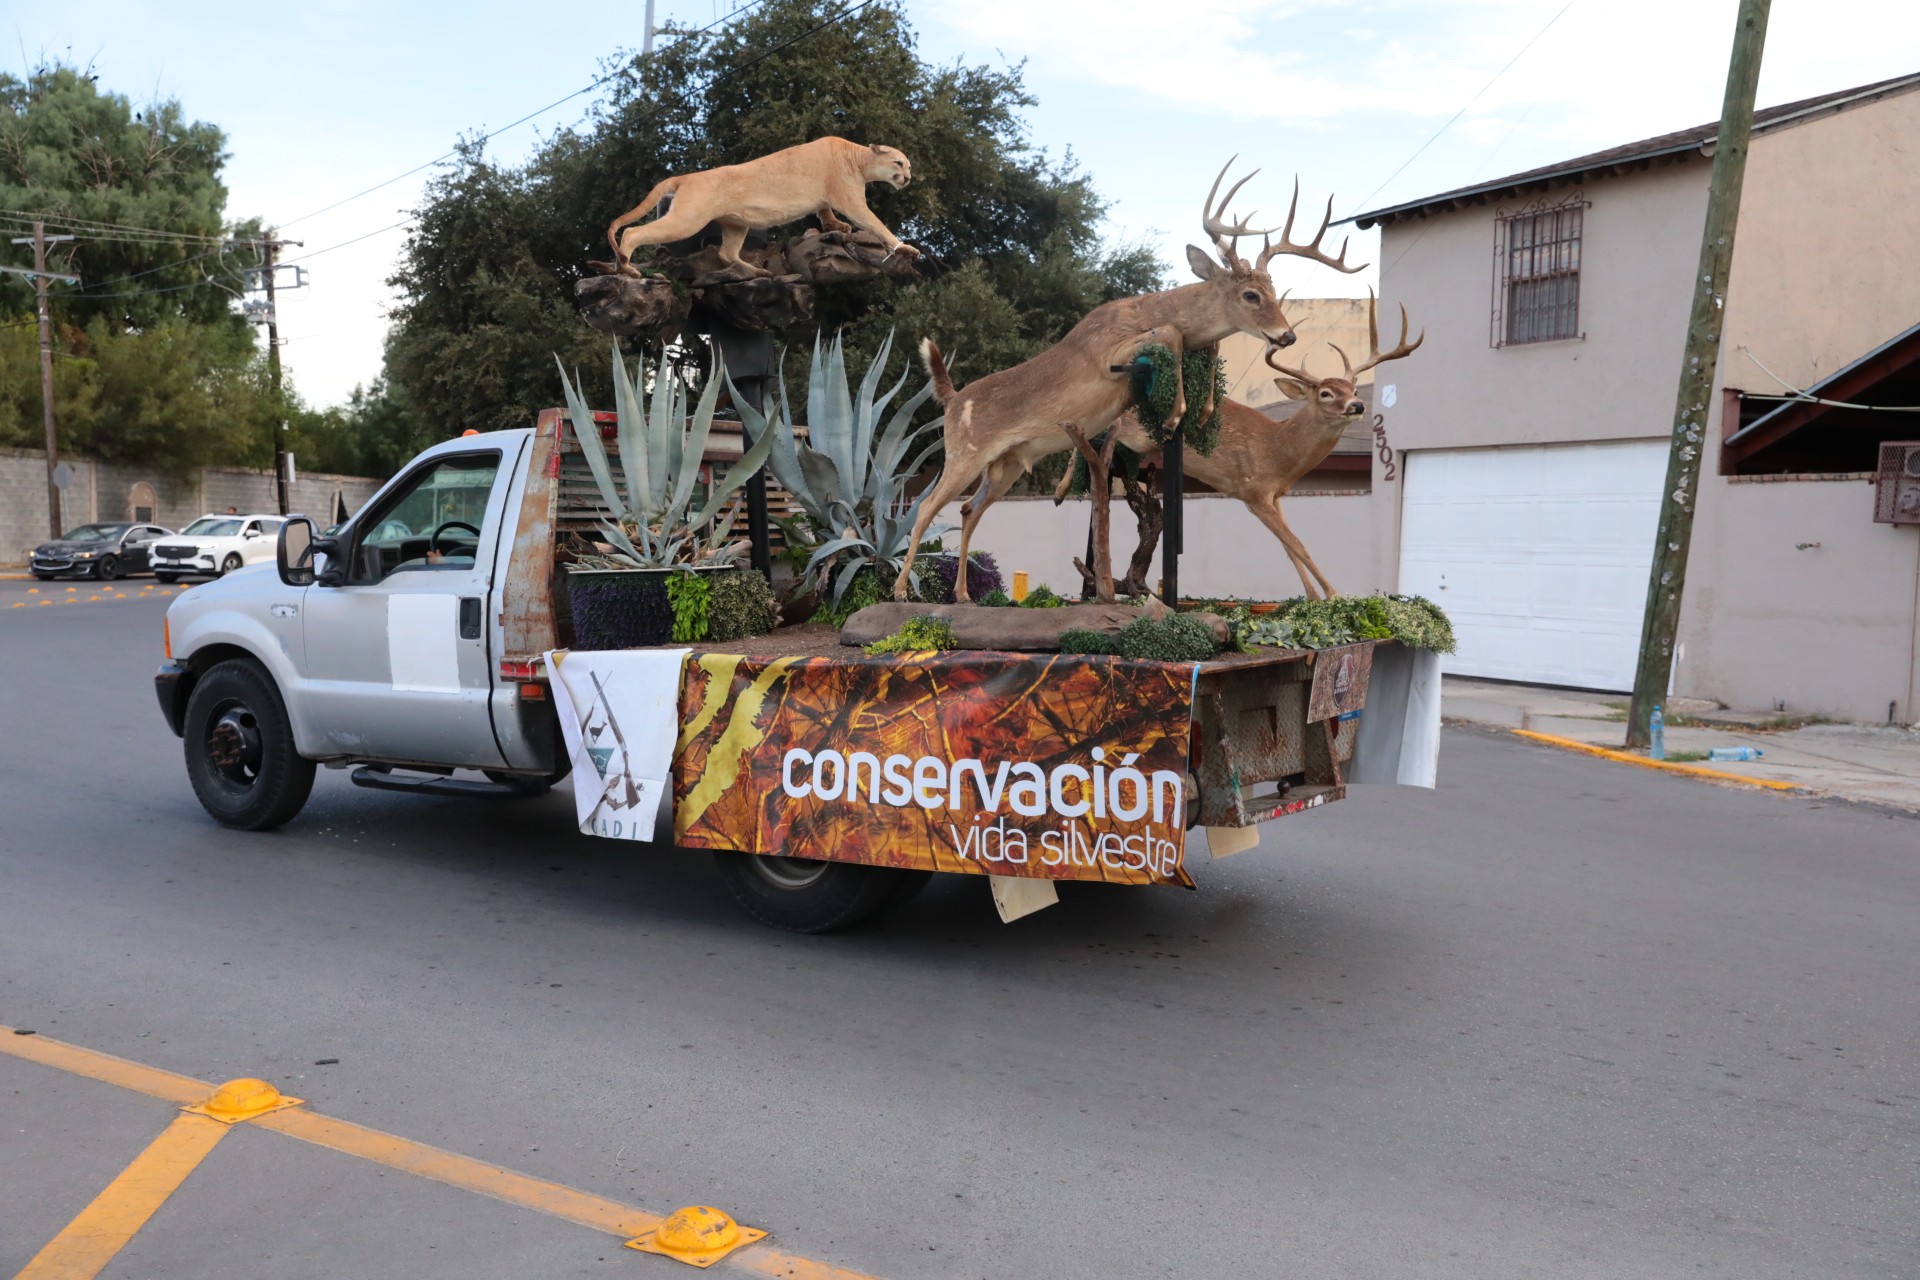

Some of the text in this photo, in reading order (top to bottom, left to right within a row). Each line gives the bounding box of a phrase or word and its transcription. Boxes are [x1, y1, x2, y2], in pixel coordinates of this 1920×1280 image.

[1373, 414, 1395, 481] 2502
[783, 747, 1182, 829] conservación
[950, 815, 1177, 877] vida silvestre
